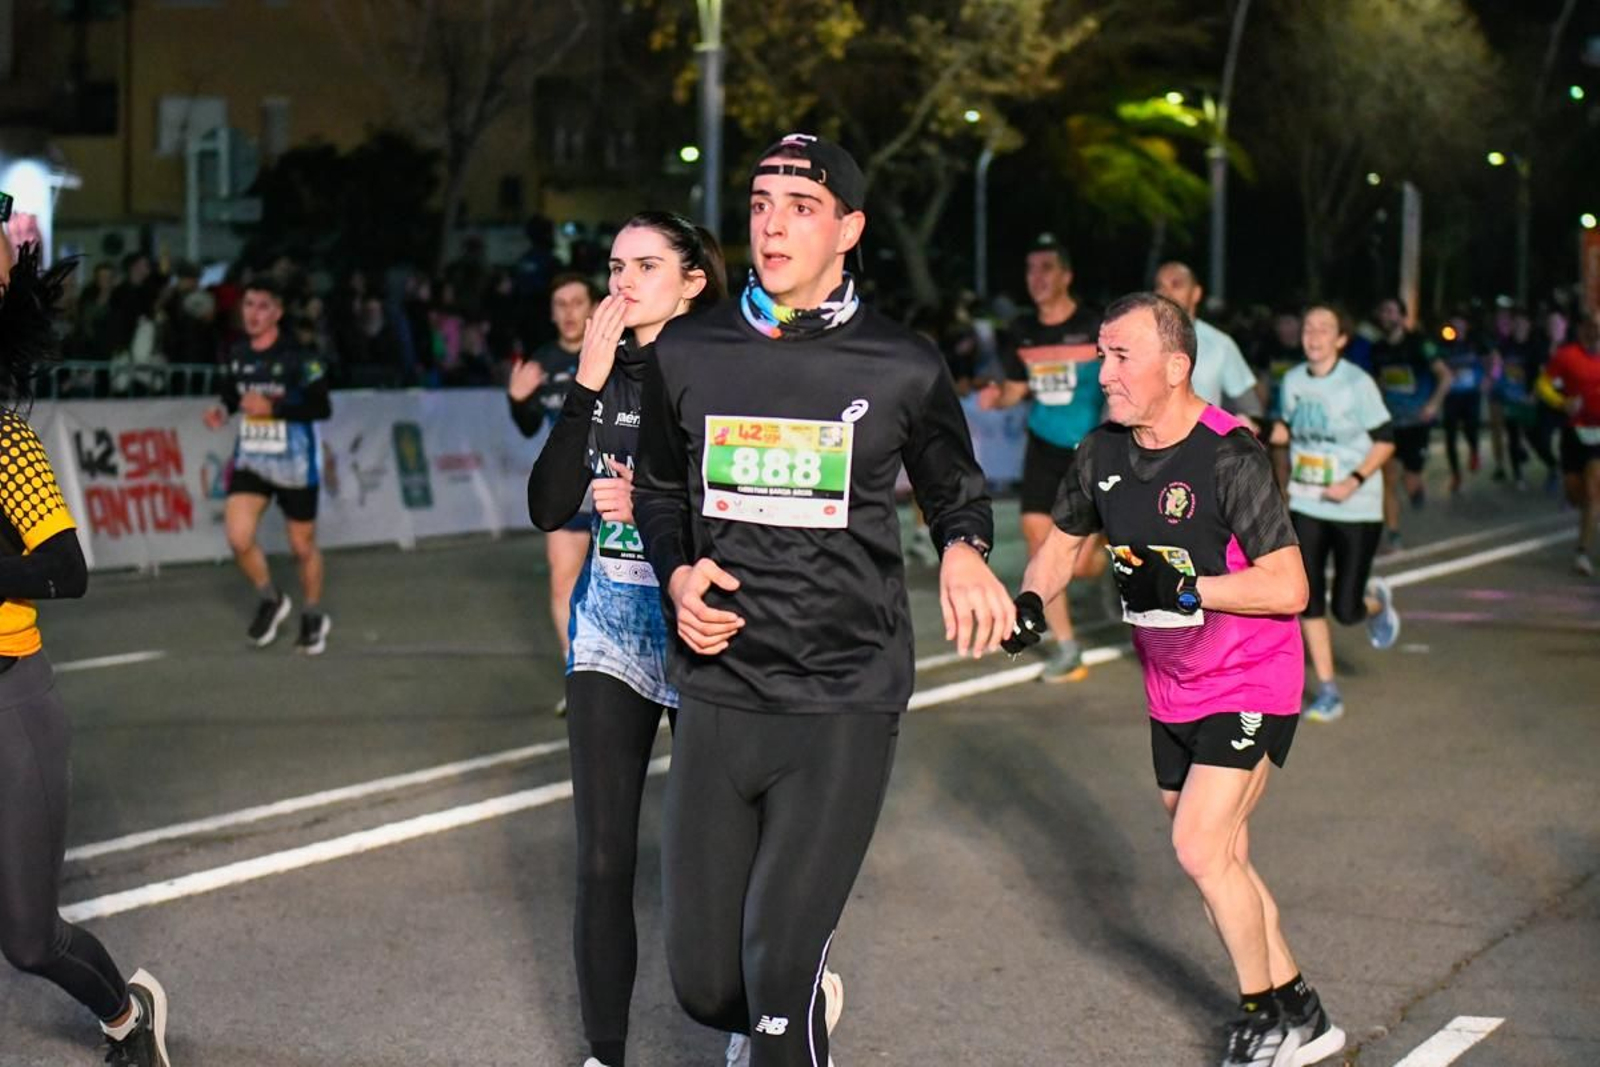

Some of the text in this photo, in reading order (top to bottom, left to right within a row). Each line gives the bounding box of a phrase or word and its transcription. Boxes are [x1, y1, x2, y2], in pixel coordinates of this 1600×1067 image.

[738, 423, 763, 441] 42
[74, 427, 118, 478] 42
[119, 427, 184, 479] SAN
[731, 447, 822, 487] 888
